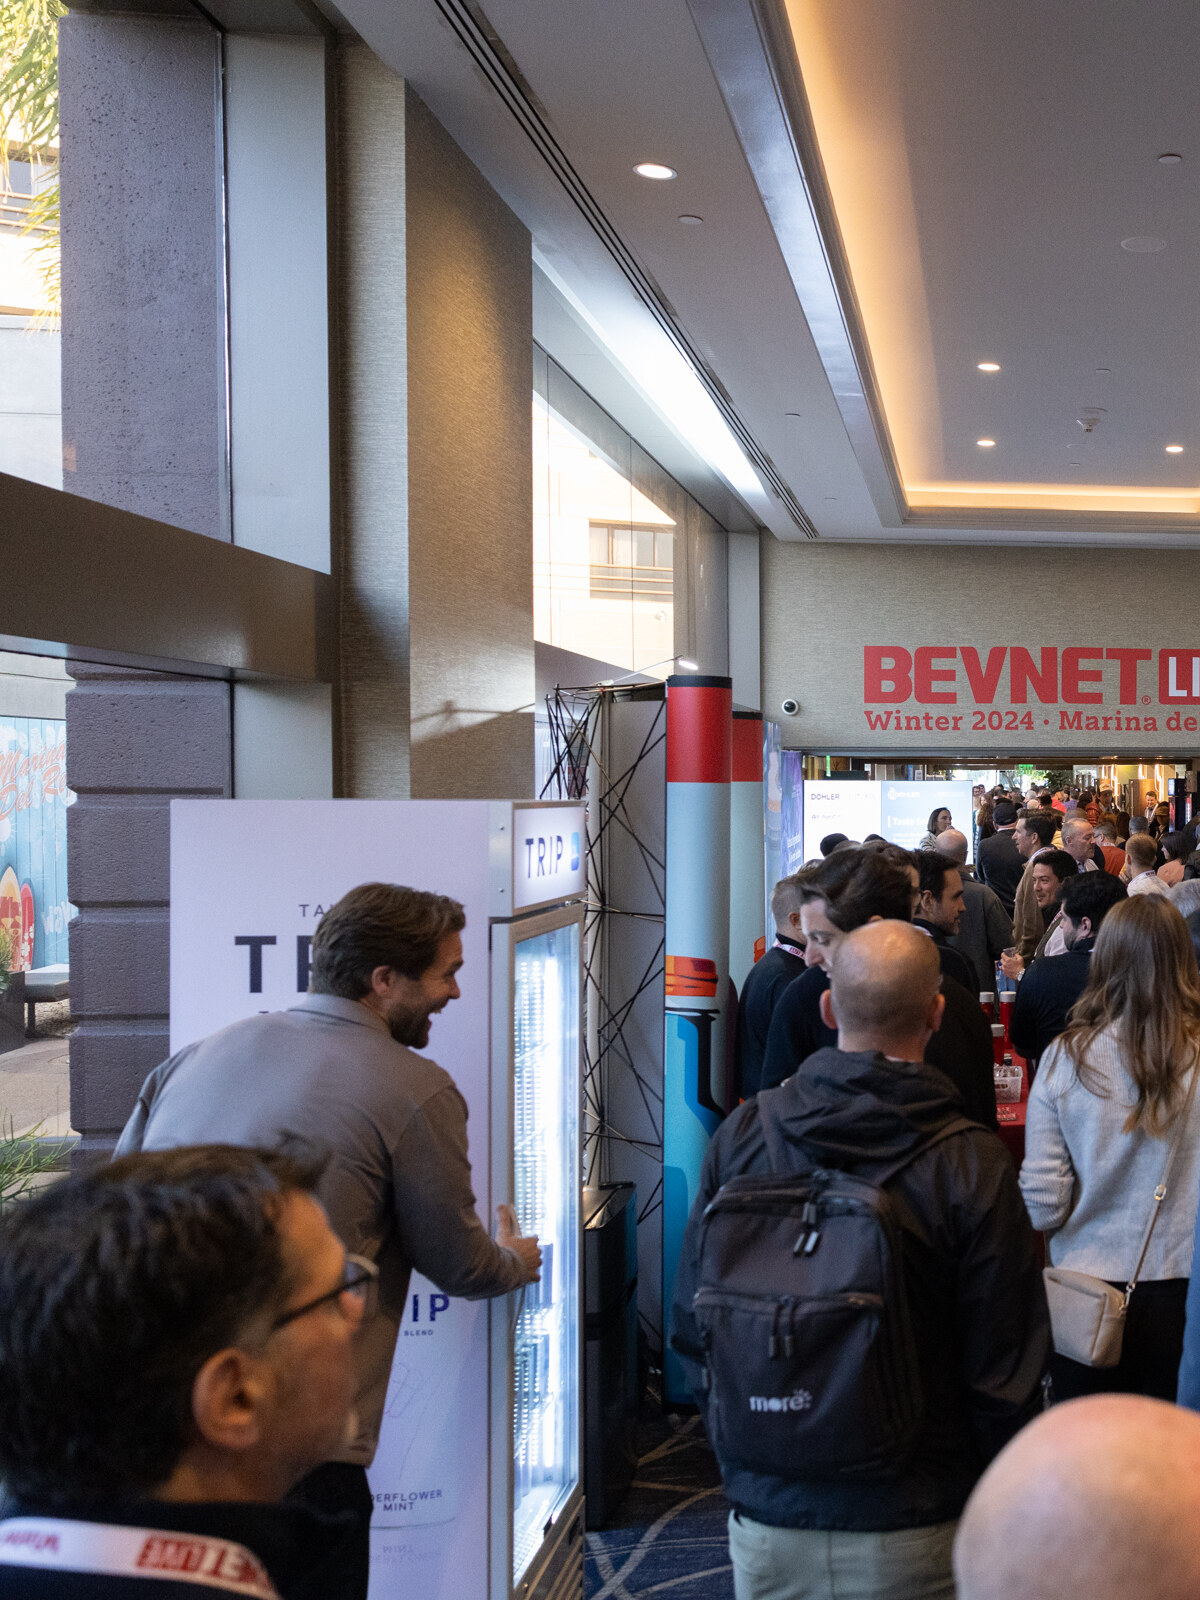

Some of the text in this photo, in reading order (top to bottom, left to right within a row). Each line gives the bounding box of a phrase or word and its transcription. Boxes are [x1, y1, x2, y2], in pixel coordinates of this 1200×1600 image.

[863, 710, 963, 732] Winter
[971, 709, 1035, 732] 2024
[1058, 710, 1159, 733] Marina
[525, 834, 564, 879] TRIP
[411, 1293, 450, 1322] IP
[404, 1329, 434, 1337] BLEND
[383, 1501, 415, 1512] MINT
